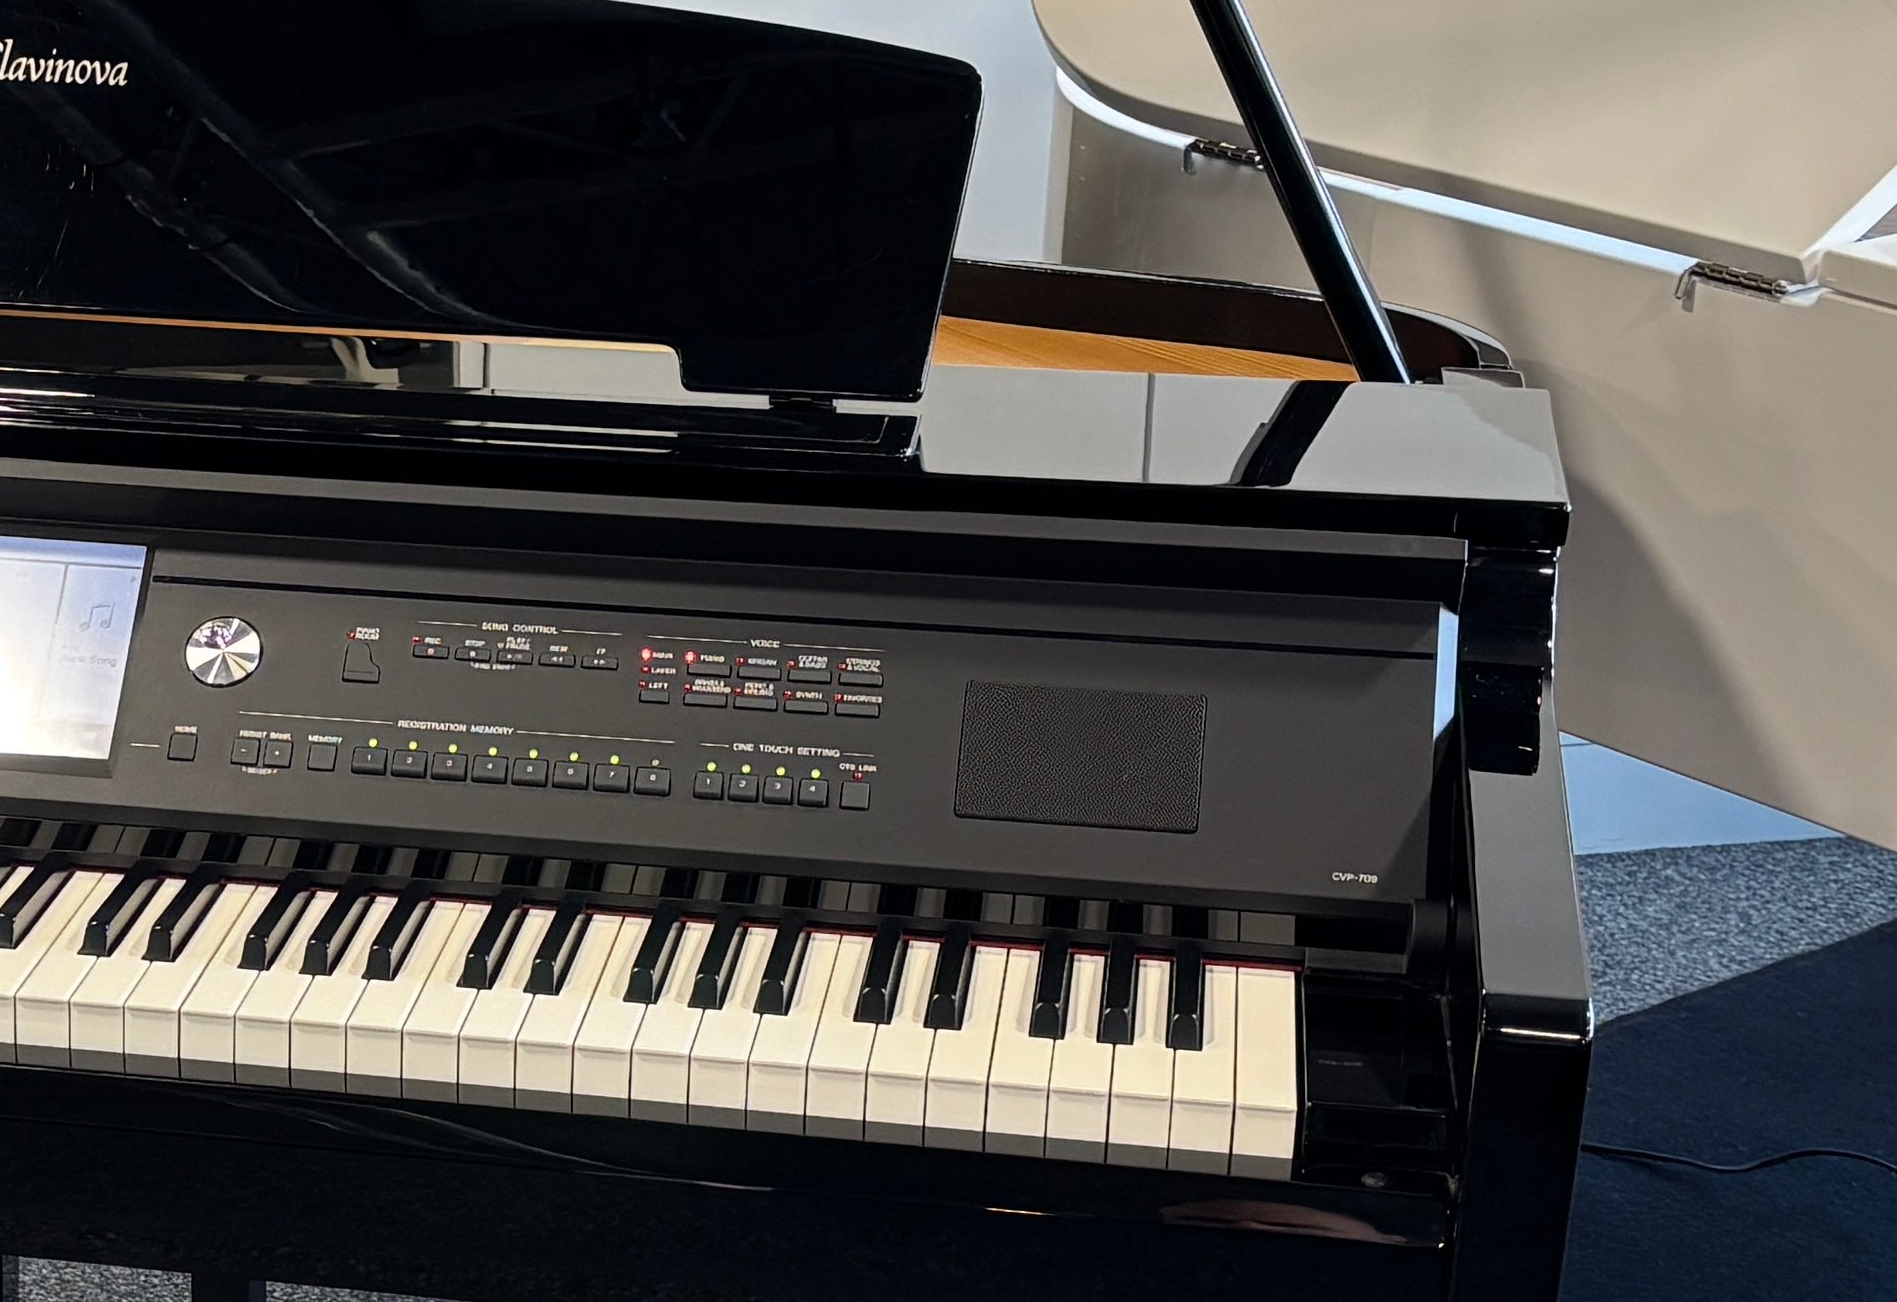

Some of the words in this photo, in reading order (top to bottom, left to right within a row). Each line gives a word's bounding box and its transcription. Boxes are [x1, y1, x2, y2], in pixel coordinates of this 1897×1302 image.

[397, 720, 467, 732] REGISTRATION
[470, 724, 514, 735] MEMORY
[1331, 872, 1378, 884] CVP-709
